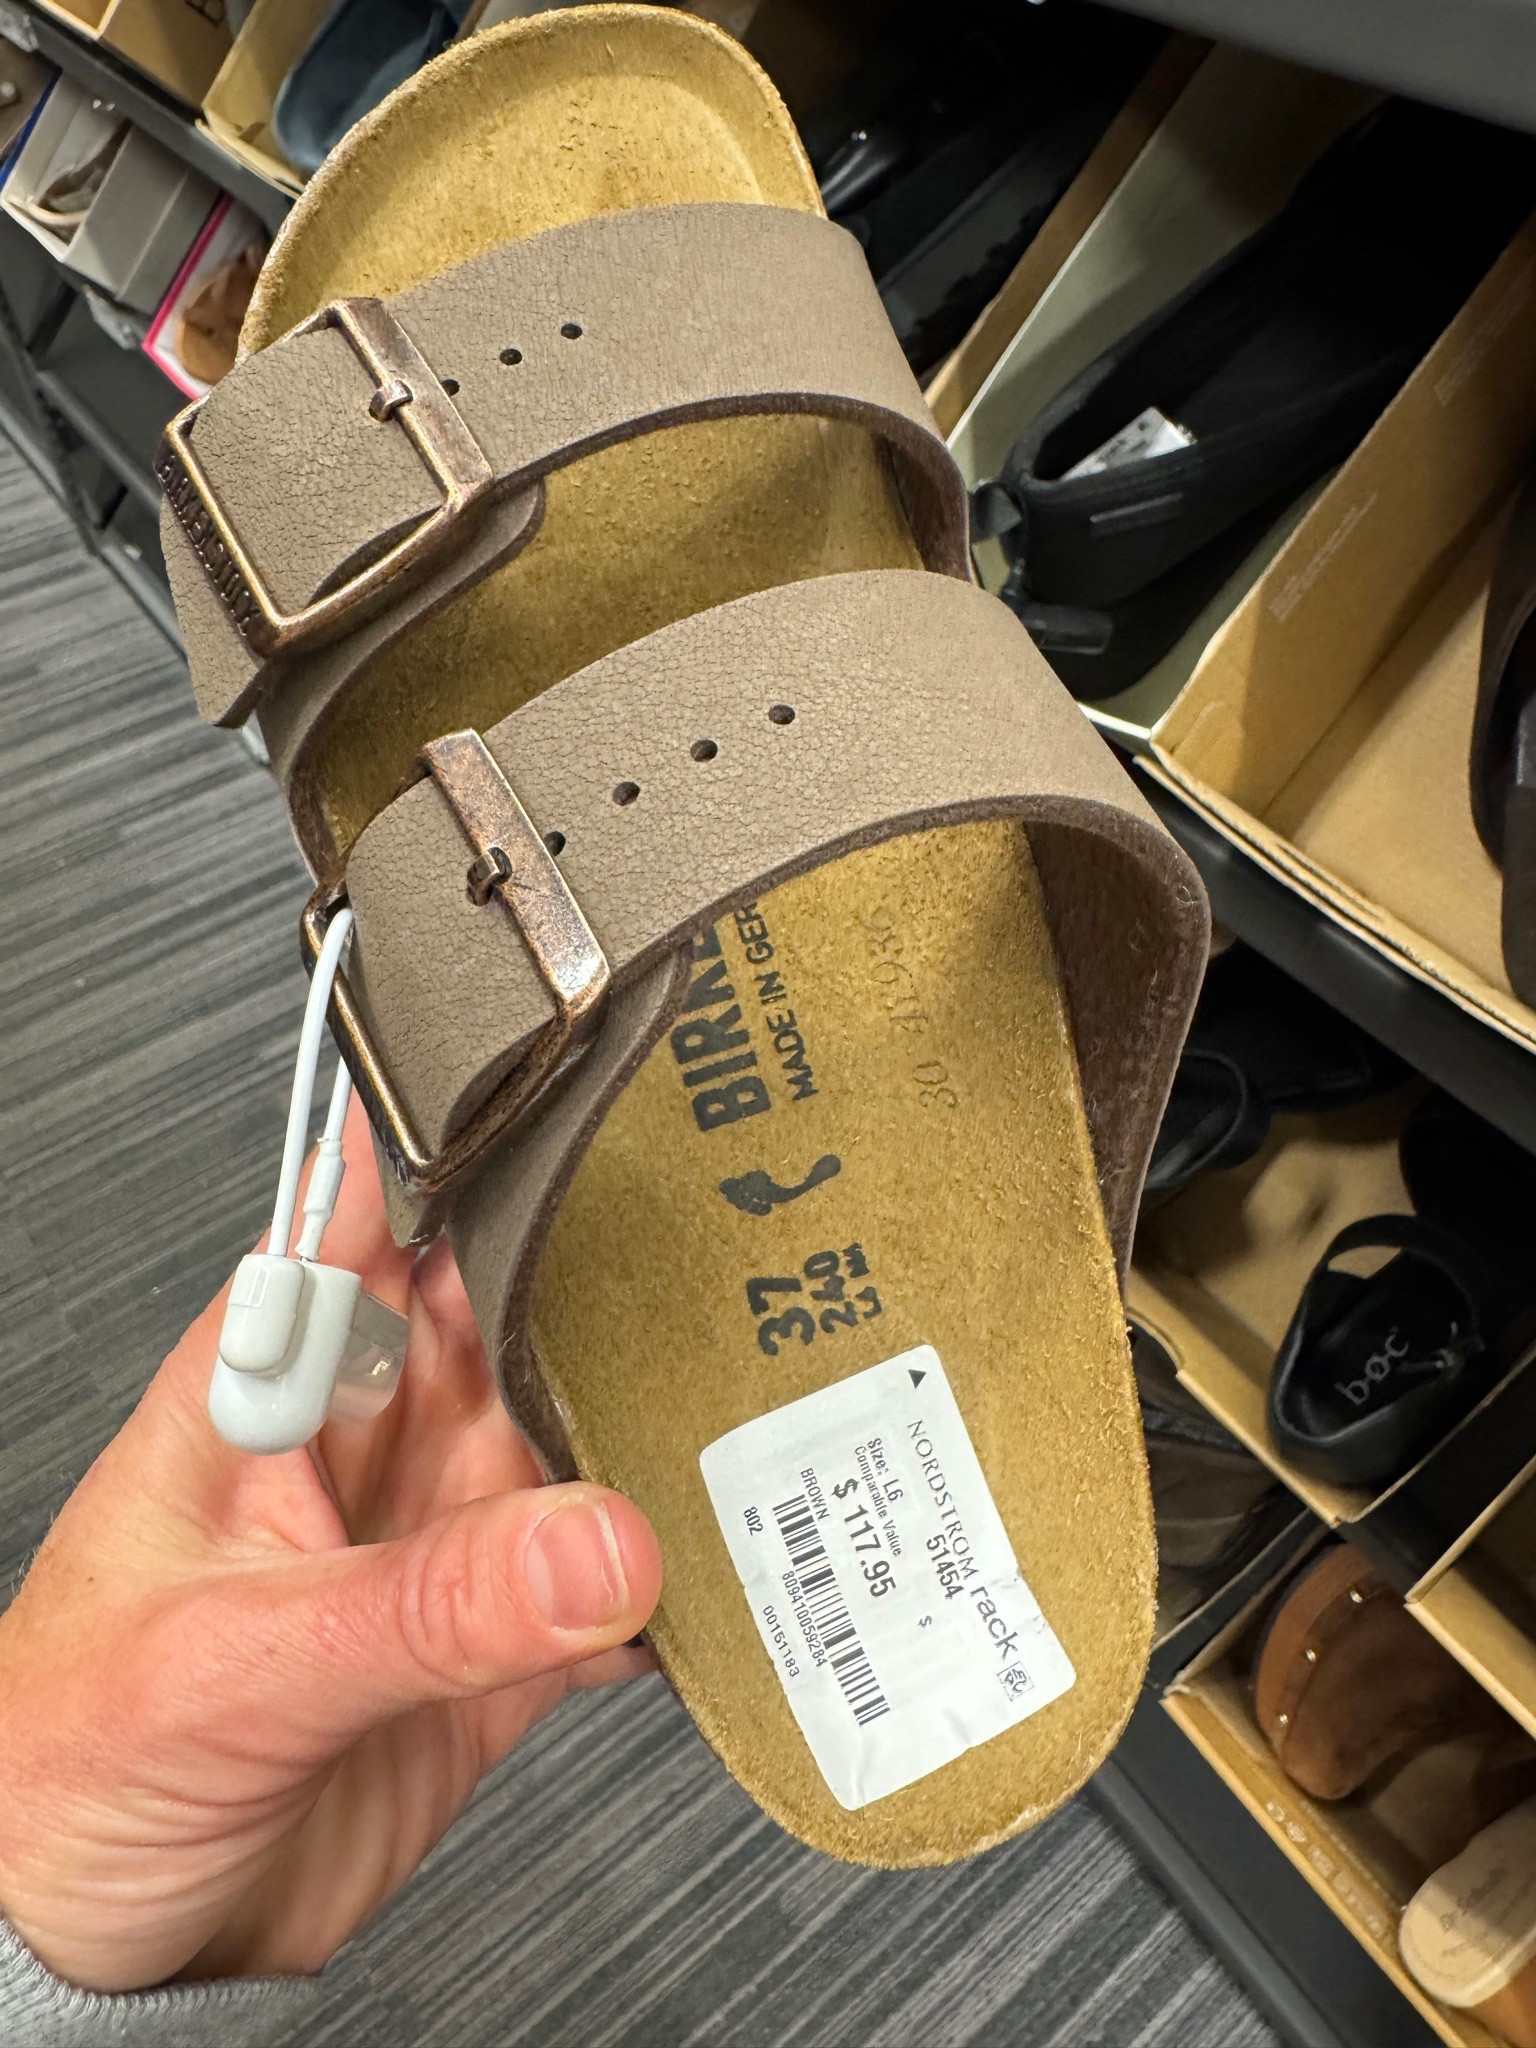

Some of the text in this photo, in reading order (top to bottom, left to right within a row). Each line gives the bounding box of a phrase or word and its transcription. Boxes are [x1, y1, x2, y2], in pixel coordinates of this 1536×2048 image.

[753, 970, 788, 1006] IN
[766, 1008, 819, 1101] MADE
[746, 1276, 816, 1357] 37
[803, 1250, 858, 1334] 240
[800, 1467, 831, 1521] BROWN
[854, 1446, 902, 1557] Comparable Value
[867, 1437, 904, 1503] Size: L6
[742, 1506, 764, 1536] 802
[833, 1477, 897, 1599] $ 117.95
[907, 1420, 1019, 1661] NORDSTROM rack
[926, 1535, 965, 1600] 51454
[781, 1570, 828, 1668] 809410059284
[918, 1615, 933, 1629] $
